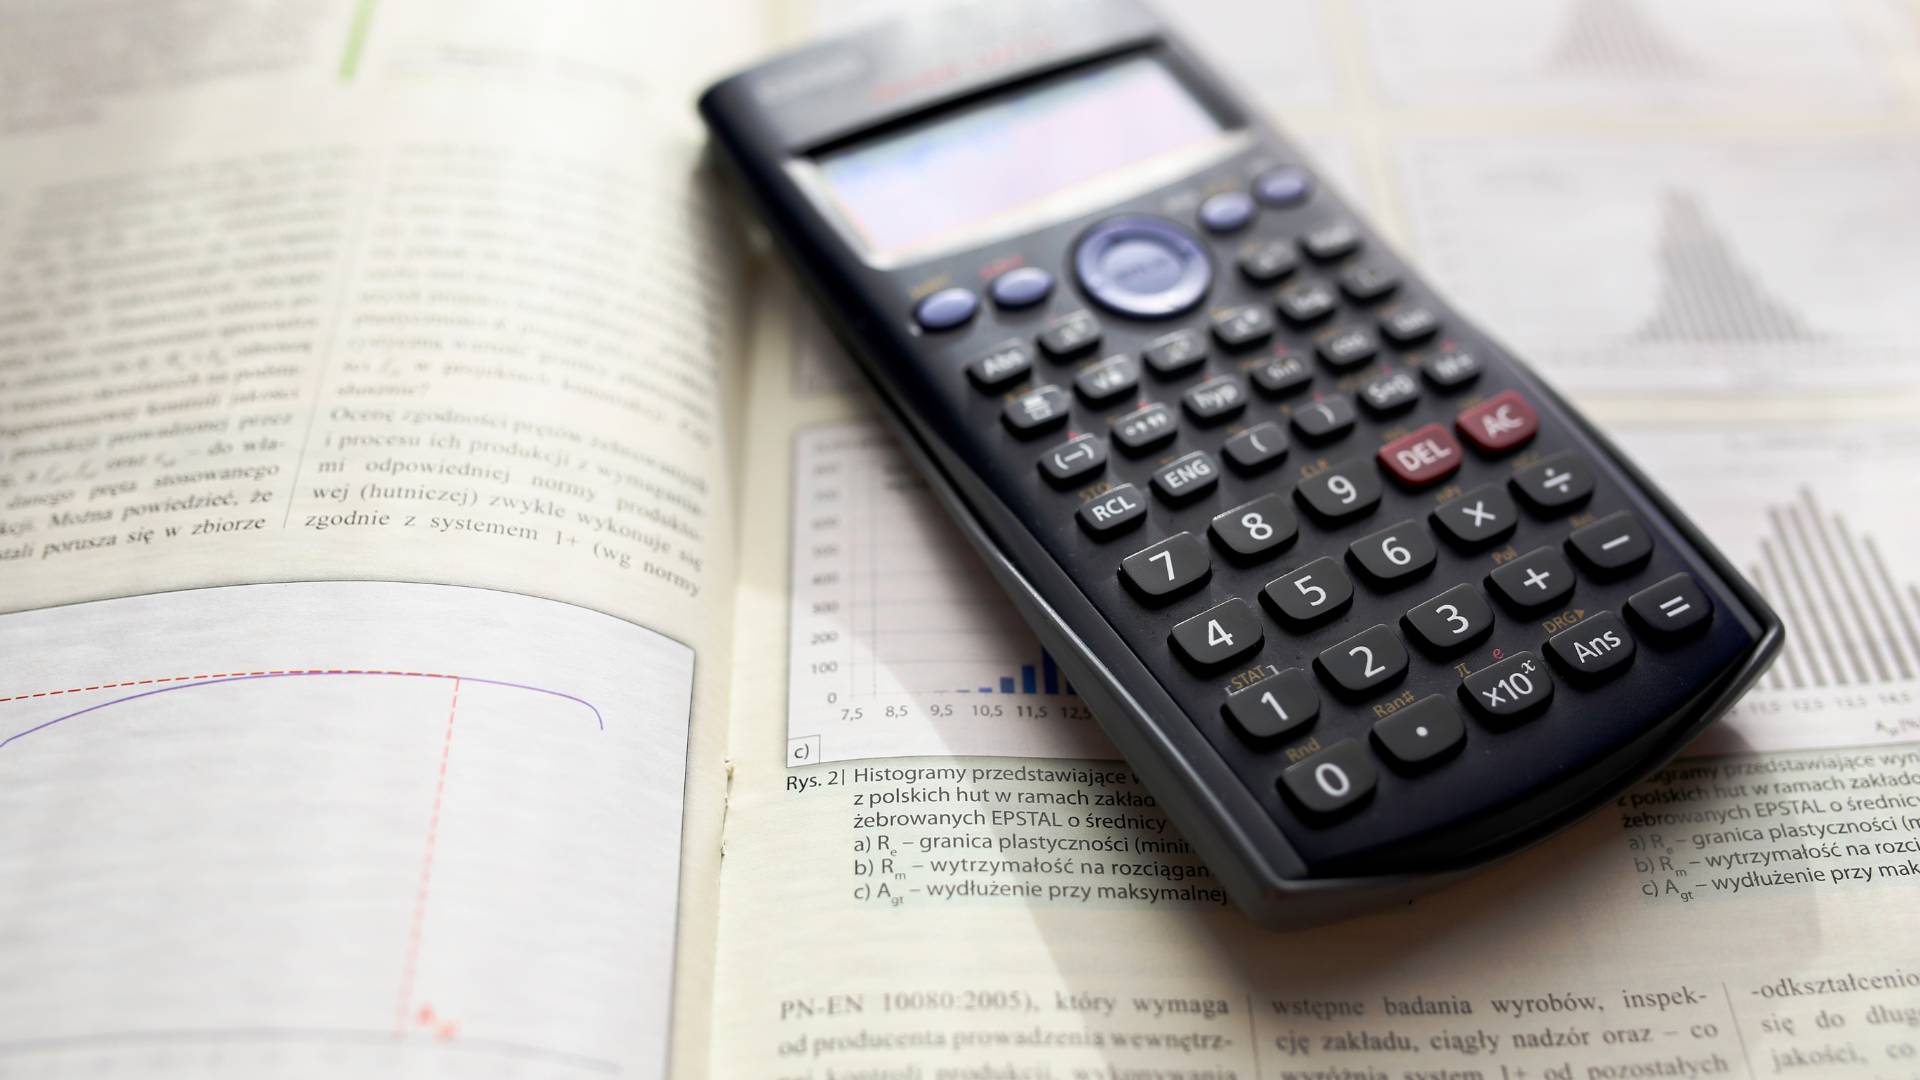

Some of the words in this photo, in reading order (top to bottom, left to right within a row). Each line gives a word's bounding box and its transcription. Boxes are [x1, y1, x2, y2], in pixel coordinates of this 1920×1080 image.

[1482, 404, 1524, 438] AC
[430, 434, 460, 449] ich
[1396, 438, 1454, 473] DEL
[318, 458, 345, 473] mi
[365, 458, 511, 482] odpowiedniej
[531, 474, 595, 502] normy
[1164, 459, 1211, 489] ENG
[1328, 475, 1358, 504] 9
[312, 484, 349, 502] wej
[360, 483, 479, 507] (hutniczej)
[489, 495, 566, 518] zwykle
[577, 511, 672, 553] wykonuje
[1091, 496, 1136, 522] RCL
[165, 525, 180, 538] w
[191, 517, 266, 536] zbiorze
[1241, 512, 1273, 540] 8
[305, 510, 390, 530] zgodnie
[404, 514, 416, 526] z
[430, 515, 538, 541] systemem
[556, 530, 578, 546] 1+
[593, 542, 631, 569] (wg
[643, 561, 700, 598] normy
[1381, 536, 1411, 565] 6
[1149, 550, 1175, 581] 7
[1294, 575, 1327, 607] 5
[1207, 619, 1234, 646] 4
[1436, 604, 1469, 634] 3
[1573, 629, 1621, 663] Ans
[811, 661, 838, 674] 100
[1349, 646, 1386, 678] 2
[827, 693, 837, 704] 0
[840, 708, 863, 721] 7,5
[885, 705, 908, 719] 8,5
[930, 704, 953, 718] 9,5
[972, 704, 1003, 718] 10,5
[1016, 705, 1048, 719] 11,5
[1261, 691, 1289, 721] 1
[1373, 690, 1415, 718] Ran#
[793, 743, 809, 759] c)
[1286, 738, 1322, 762] Rnd
[787, 775, 822, 793] Rys.
[854, 767, 966, 784] Histogramy
[972, 766, 1127, 787] przedstawiające
[1315, 762, 1350, 797] 0
[1723, 753, 1875, 778] przedstawiające
[854, 794, 864, 806] z
[869, 787, 950, 808] polskich
[956, 787, 990, 803] hut
[995, 791, 1011, 802] w
[1018, 790, 1089, 806] ramach
[1094, 792, 1158, 807] zakład
[1631, 785, 1710, 808] polskich
[1713, 782, 1747, 799] hut
[1752, 784, 1769, 797] w
[1774, 777, 1845, 795] ramach
[854, 810, 985, 829] żebrowanych
[992, 810, 1062, 827] EPSTAL
[1068, 816, 1080, 828] o
[1086, 812, 1167, 834] średnicy
[1623, 803, 1751, 828] żebrowanych
[1755, 798, 1827, 818] EPSTAL
[1830, 801, 1843, 813] o
[854, 836, 871, 853] a)
[919, 834, 992, 853] granica
[999, 833, 1129, 853] plastyczności
[1629, 833, 1647, 851] a)
[1692, 827, 1764, 849] granica
[1769, 816, 1898, 844] plastyczności
[854, 860, 874, 877] b)
[930, 857, 1073, 876] wytrzymałość
[1081, 862, 1104, 875] na
[1111, 861, 1214, 881] rozciągan
[1635, 857, 1655, 875] b)
[1706, 841, 1842, 869] wytrzymałość
[1846, 844, 1870, 857] na
[854, 884, 871, 901] c)
[926, 880, 1042, 900] wydłużenie
[1049, 882, 1092, 901] przy
[1097, 882, 1228, 906] maksymalnej
[1642, 880, 1659, 898] c)
[1712, 867, 1826, 893] wydłużenie
[1831, 864, 1872, 884] przy
[1879, 860, 1920, 877] mak
[780, 993, 864, 1021] PN-EN
[882, 989, 1040, 1014] 10080:2005),
[1056, 990, 1116, 1016] który
[1131, 998, 1230, 1020] wymaga
[1271, 998, 1364, 1021] wstępne
[1383, 995, 1473, 1016] badania
[1492, 992, 1604, 1018] wyrobów,
[1623, 985, 1707, 1013] inspek-
[1761, 1013, 1795, 1035] się
[1815, 1010, 1845, 1029] do
[778, 1034, 807, 1057] od
[813, 1029, 947, 1058] producenta
[952, 1027, 1104, 1051] prowadzenia
[1111, 1033, 1232, 1051] wewnętrz-
[1275, 1030, 1310, 1055] cję
[1322, 1031, 1419, 1053] zakładu,
[1429, 1029, 1499, 1054] ciągły
[1512, 1028, 1590, 1049] nadzór
[1602, 1028, 1652, 1044] oraz
[1690, 1023, 1718, 1039] co
[1886, 1042, 1915, 1059] co
[1587, 1052, 1730, 1080] pozostałych
